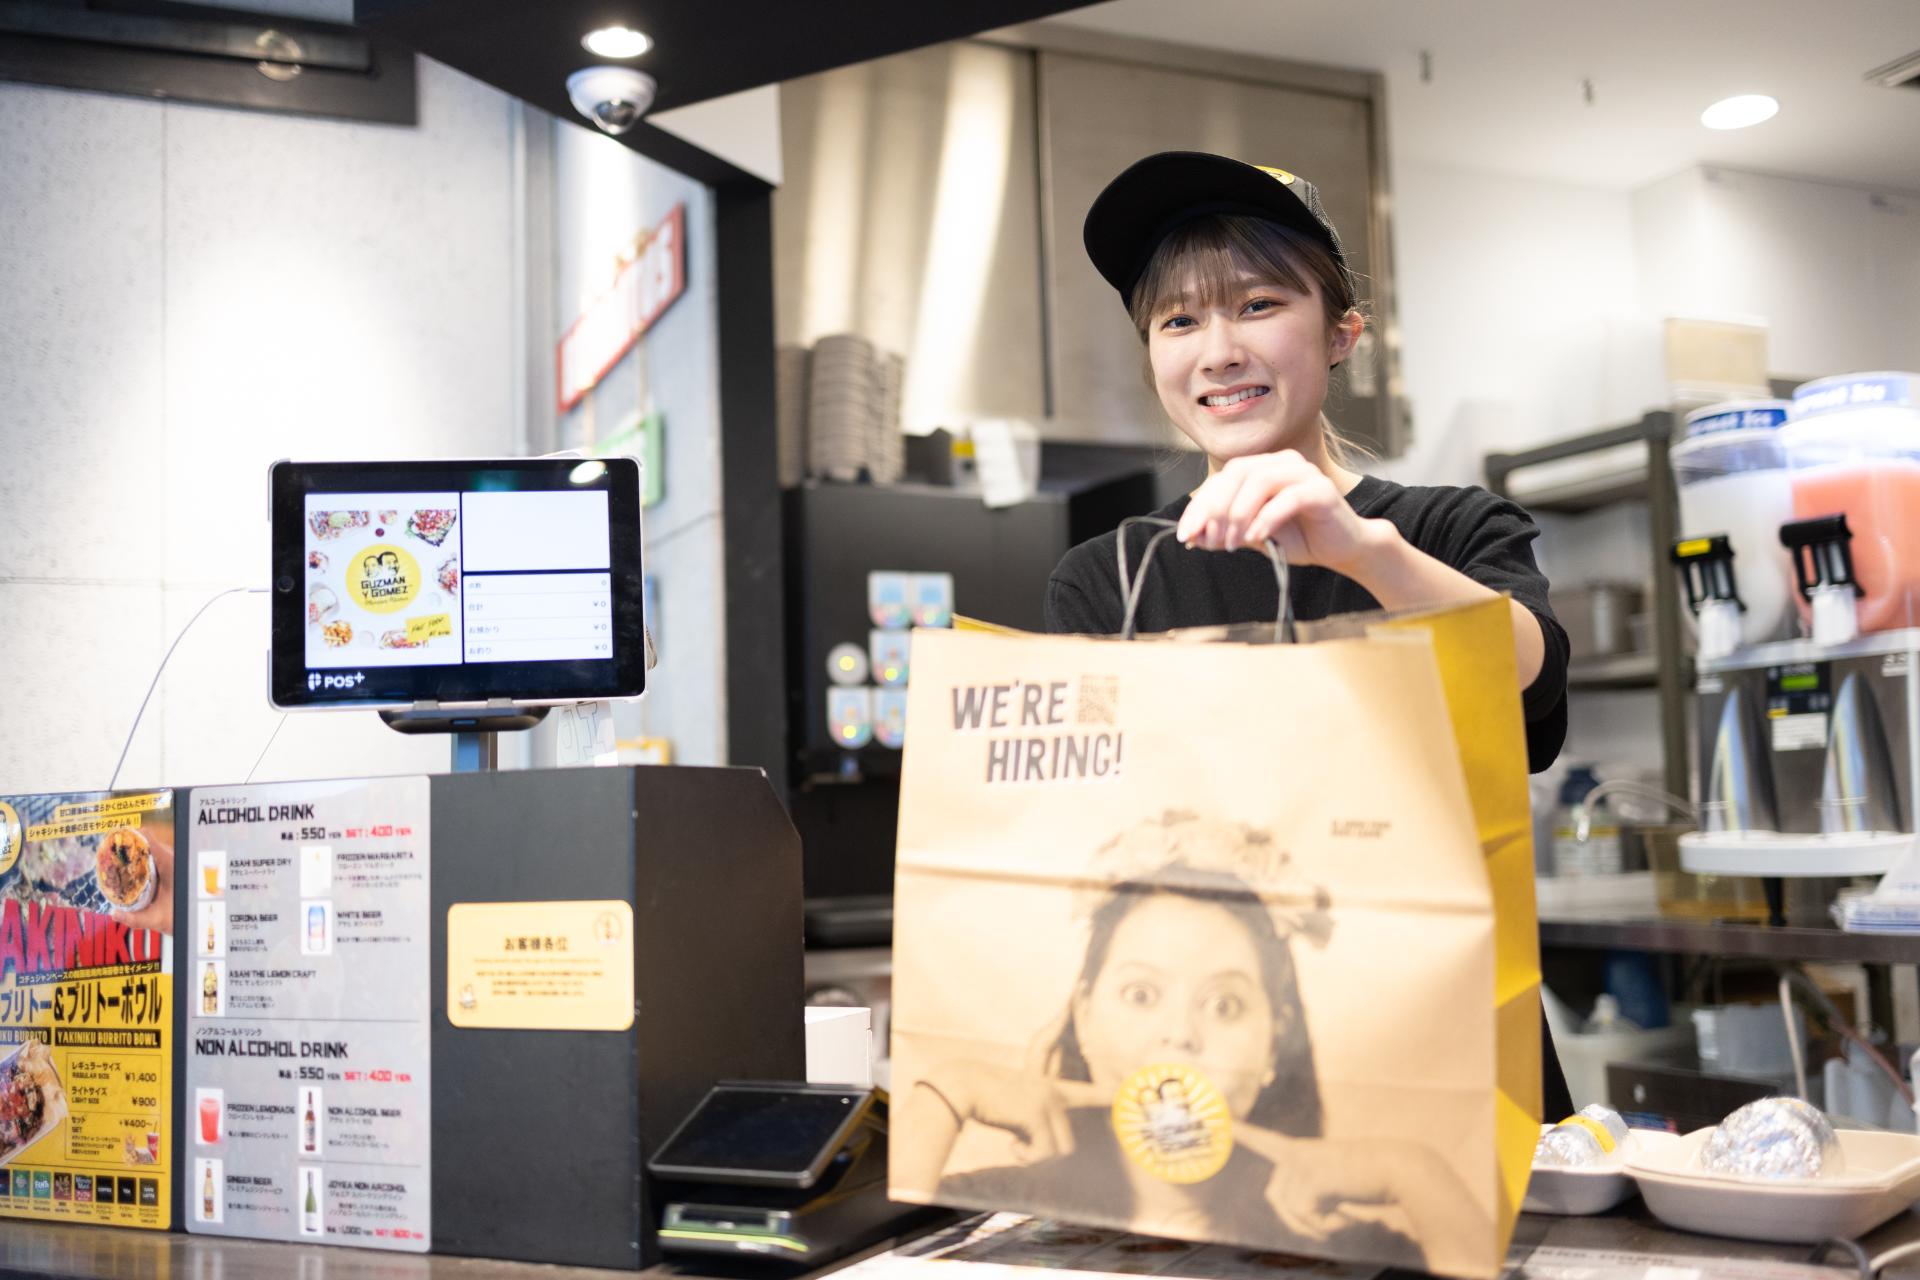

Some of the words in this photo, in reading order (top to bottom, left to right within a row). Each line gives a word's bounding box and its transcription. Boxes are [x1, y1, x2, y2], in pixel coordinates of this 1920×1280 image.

[361, 576, 405, 589] GUZMAN
[362, 591, 368, 600] Y
[371, 585, 408, 598] GOMEZ
[324, 672, 365, 688] POS+
[952, 679, 1068, 730] WE'RE
[986, 732, 1122, 782] HIRING!
[198, 806, 265, 825] ALCOHOL
[269, 803, 315, 821] DRINK
[300, 827, 325, 840] 550
[229, 859, 250, 867] ASAHI
[252, 859, 275, 867] SUPER
[277, 858, 291, 866] DRY
[230, 914, 257, 922] CORONA
[252, 970, 265, 978] THE
[267, 970, 291, 978] LEMON
[196, 1027, 262, 1036] ノンアルコールドリンク
[58, 1031, 96, 1044] YAKINIKU
[98, 1032, 132, 1045] BURRITO
[134, 1033, 157, 1046] BOWL
[195, 1039, 225, 1056] NON
[228, 1040, 297, 1057] ALCOHOL
[301, 1041, 348, 1058] DRINK
[72, 1062, 120, 1071] レギュラーサイズ
[126, 1073, 157, 1083] ¥1,400
[299, 1067, 325, 1080] 550
[369, 1070, 392, 1082] 400
[72, 1086, 107, 1095] ライトサイズ
[132, 1097, 157, 1107] ¥900
[253, 1177, 272, 1185] BEER
